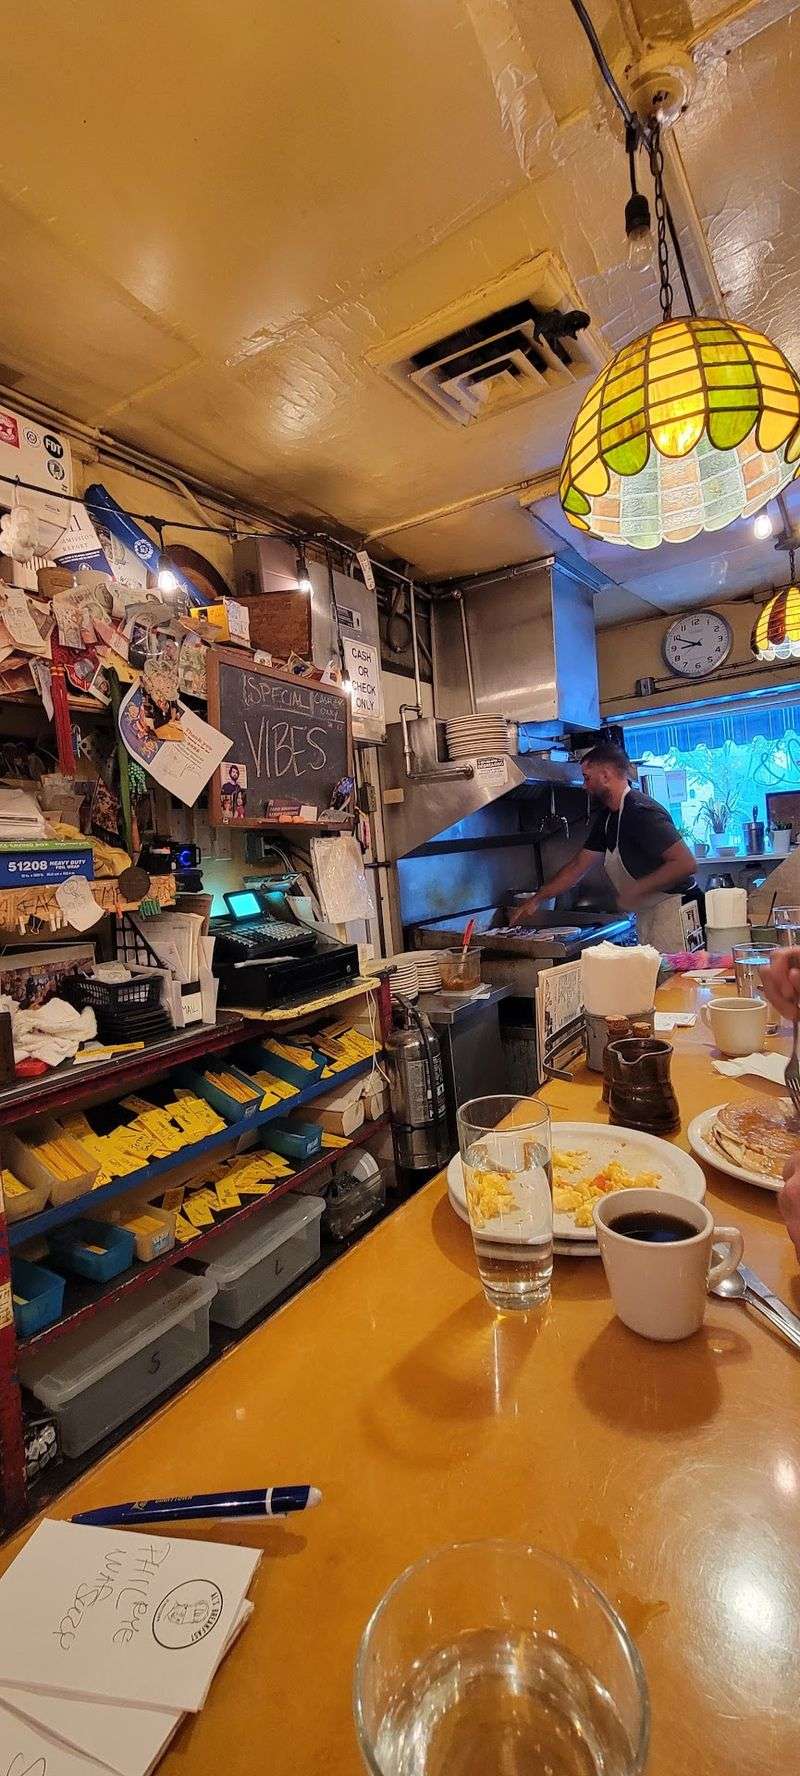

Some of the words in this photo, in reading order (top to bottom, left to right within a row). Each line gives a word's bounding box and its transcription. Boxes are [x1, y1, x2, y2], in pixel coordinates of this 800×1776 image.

[45, 440, 61, 455] FDT
[351, 647, 372, 663] CASH
[357, 665, 369, 677] OR
[247, 676, 311, 709] SPECIAL
[351, 680, 376, 696] CHECK
[355, 697, 375, 711] ONLY
[243, 716, 328, 778] VIBES
[8, 860, 48, 872] 51208
[190, 1608, 219, 1642] BREAKFAST
